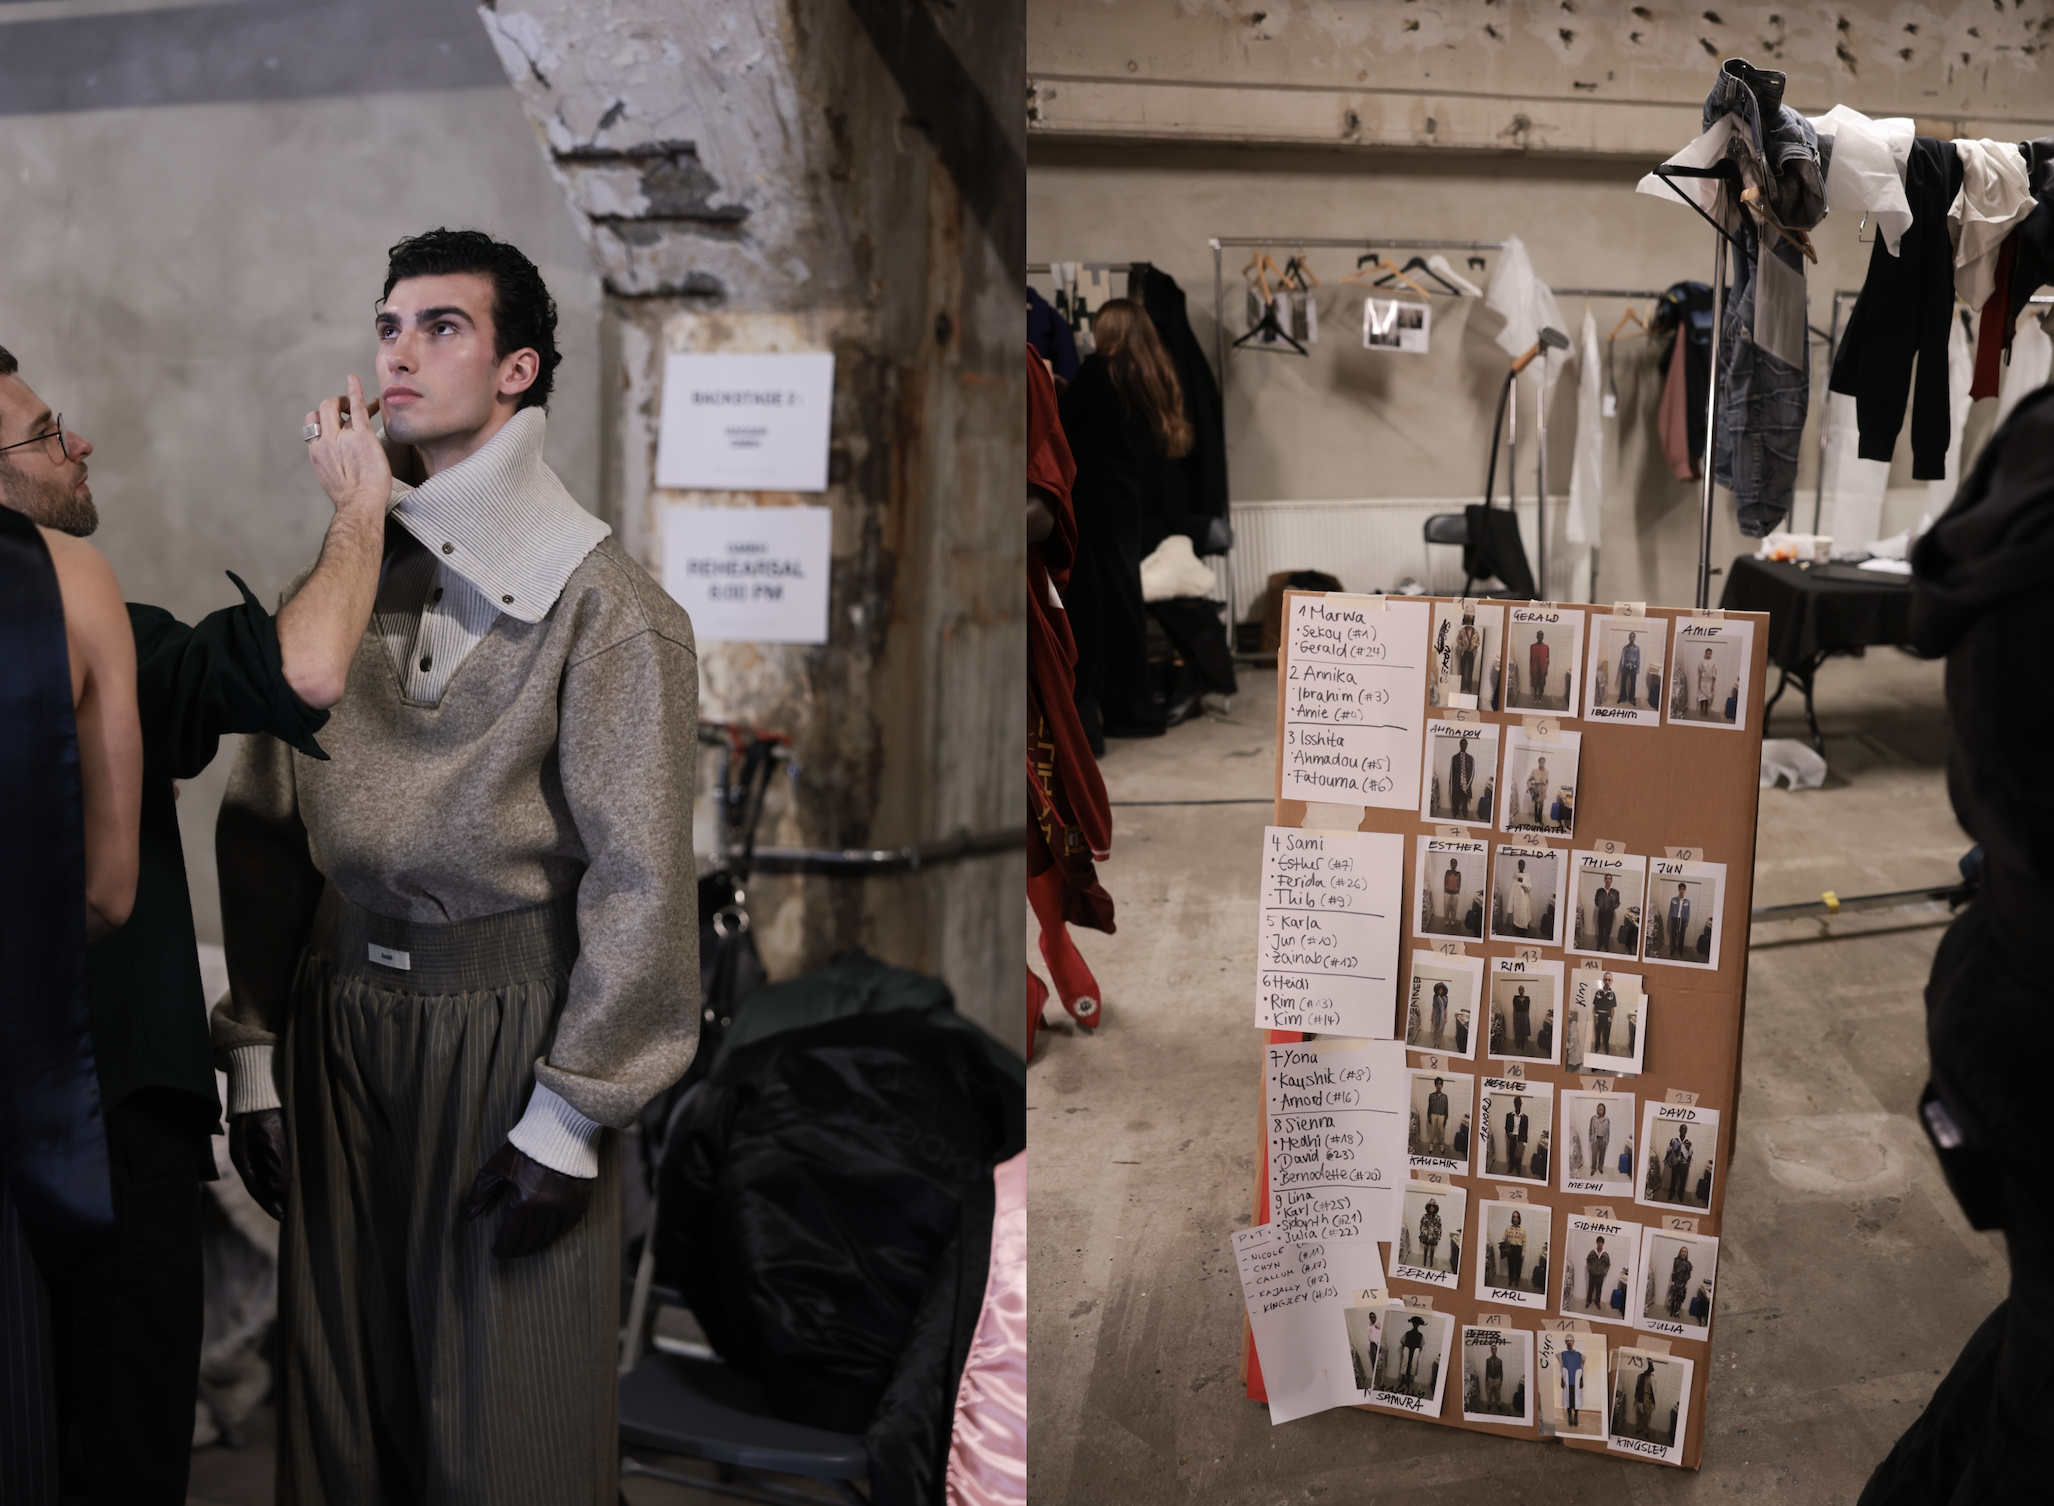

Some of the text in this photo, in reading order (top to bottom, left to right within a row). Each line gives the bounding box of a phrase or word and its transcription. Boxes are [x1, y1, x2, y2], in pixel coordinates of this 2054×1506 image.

[687, 559, 805, 579] REHEARSAL
[752, 582, 784, 602] PM
[1310, 605, 1366, 625] Marwa
[1513, 610, 1559, 622] GERALD
[1623, 604, 1632, 616] 3
[1682, 625, 1722, 636] AMIE
[1300, 642, 1387, 660] Gerald (#24)
[1289, 666, 1357, 685] 2 Annika
[1298, 687, 1389, 705] Ibrahim (#3)
[1297, 704, 1364, 722] Amie (#4)
[1457, 710, 1470, 721] 5
[1591, 709, 1637, 719] IBRAHIM
[1537, 720, 1548, 735] 6
[1288, 729, 1345, 747] 3 Isshita
[1294, 750, 1391, 772] Ahmadou (#5)
[1293, 769, 1393, 793] Fatouma (#6)
[1450, 828, 1460, 836] 7
[1272, 835, 1323, 851] 4 Sami
[1428, 841, 1484, 852] ESTHER
[1523, 834, 1539, 846] 26
[1501, 847, 1557, 859] FERIDA
[1605, 842, 1614, 854] 9
[1582, 857, 1622, 868] THILO
[1676, 850, 1692, 861] 10
[1328, 858, 1353, 872] (#7)
[1657, 863, 1683, 874] JUN
[1277, 873, 1367, 891] Ferida (#26)
[1321, 893, 1352, 907] (#9)
[1267, 915, 1321, 930] 5 Karla
[1271, 934, 1337, 950] Jun (#10)
[1440, 944, 1457, 956] 12
[1522, 950, 1538, 963] 13
[1273, 950, 1358, 969] Zainab (#12)
[1500, 961, 1525, 972] RIM
[1263, 975, 1309, 990] 6 Heidi
[1575, 982, 1588, 1007] KIM
[1271, 994, 1333, 1012] Rim (#13)
[1274, 1012, 1340, 1026] Kim (#14)
[1270, 1051, 1283, 1067] 7
[1430, 1056, 1438, 1069] 8
[1339, 1066, 1371, 1082] (#8)
[1592, 1079, 1608, 1093] 18
[1326, 1089, 1360, 1105] (#16)
[1675, 1093, 1692, 1104] 23
[1479, 1098, 1492, 1142] ARNORD
[1659, 1107, 1696, 1120] DAVID
[1274, 1116, 1335, 1133] 8 Sienna
[1325, 1131, 1363, 1149] (#18)
[1277, 1149, 1319, 1171] David
[1279, 1163, 1381, 1186] Bernadette (#20)
[1568, 1182, 1603, 1191] MEDHI
[1509, 1190, 1523, 1199] 25
[1275, 1195, 1282, 1209] 9
[1283, 1196, 1351, 1219] Karl (#25)
[1595, 1209, 1609, 1219] 21
[1285, 1225, 1359, 1244] Julia (#22)
[1574, 1221, 1621, 1234] SIDHANT
[1251, 1246, 1285, 1260] NICOLE
[1253, 1262, 1281, 1273] CHYN
[1397, 1266, 1447, 1282] BERNA
[1256, 1269, 1294, 1284] CALLUM
[1259, 1284, 1300, 1297] KAJALLY
[1362, 1289, 1378, 1299] 15
[1492, 1289, 1526, 1301] KARL
[1557, 1320, 1574, 1331] 11
[1646, 1321, 1684, 1334] JULIA
[1627, 1355, 1643, 1368] 19
[1376, 1392, 1424, 1411] SAMURA
[1616, 1437, 1667, 1458] KINGSLEY
